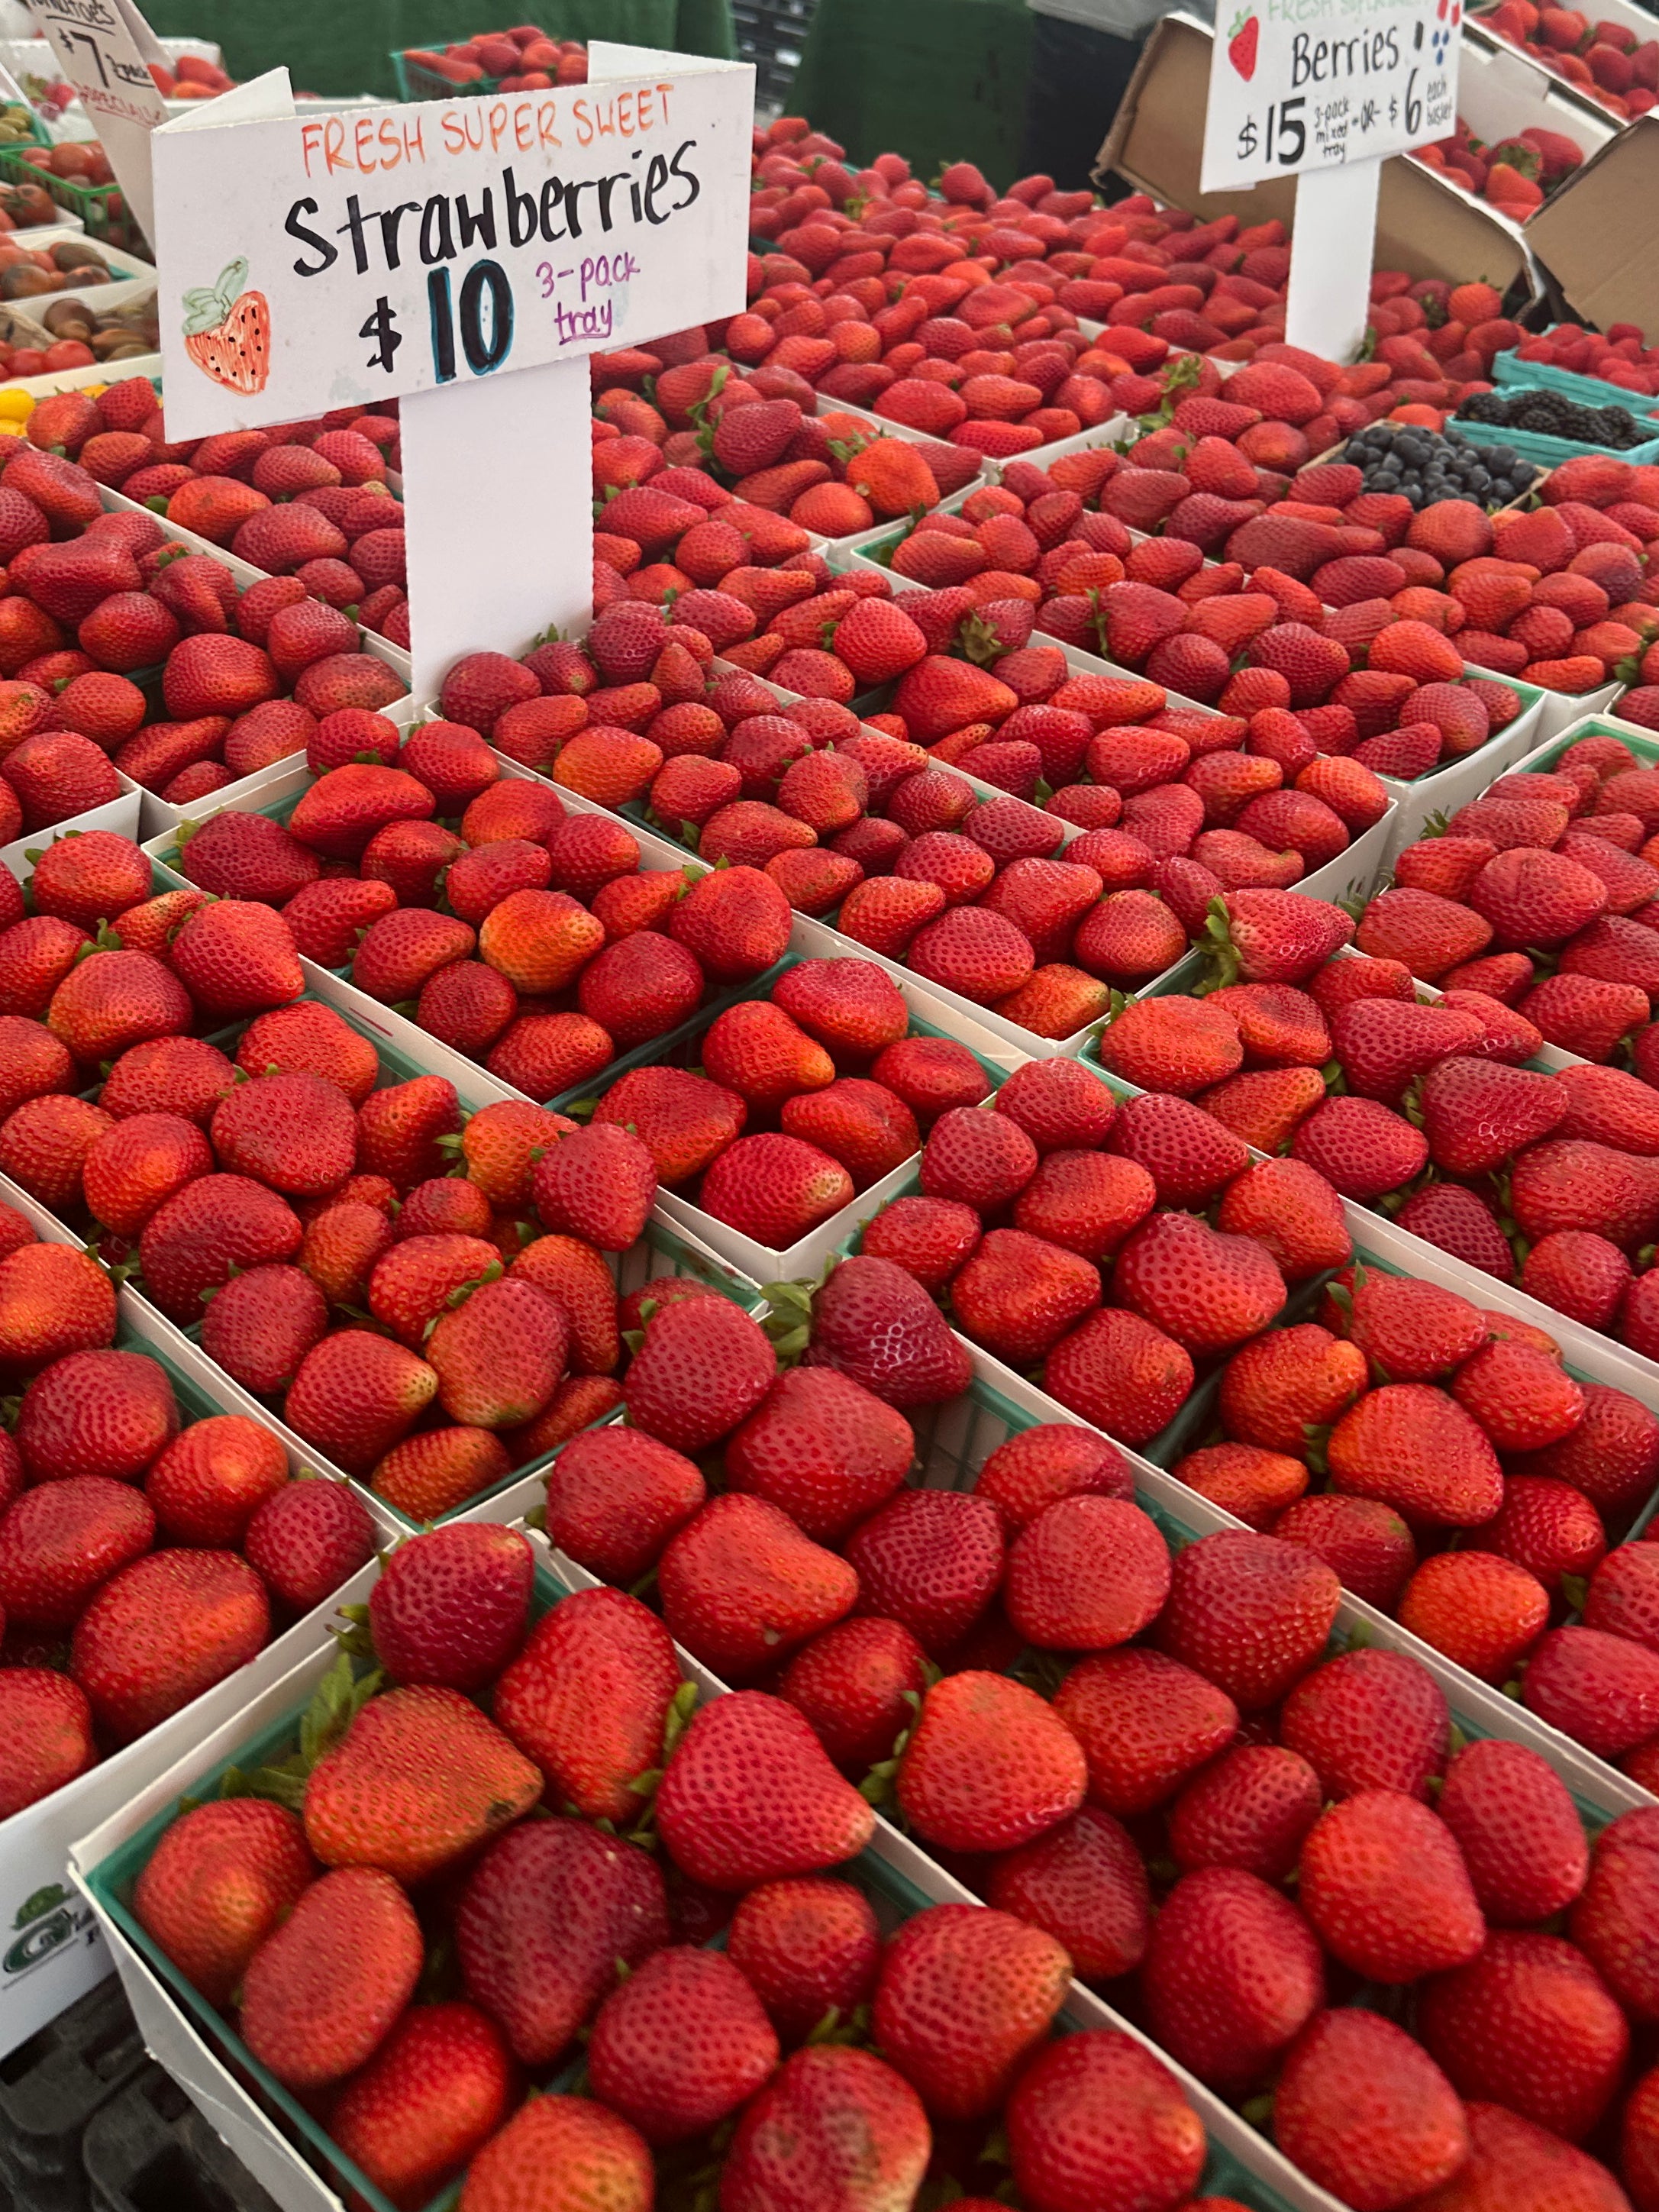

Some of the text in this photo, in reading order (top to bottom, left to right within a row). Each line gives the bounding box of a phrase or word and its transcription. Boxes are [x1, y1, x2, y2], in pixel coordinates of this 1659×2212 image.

[1292, 26, 1399, 89] Berries
[301, 84, 675, 179] FRESH SUPER SWEET
[1237, 96, 1306, 166] $15
[284, 140, 702, 277] Strawberries
[535, 250, 641, 302] 3-pack
[554, 299, 614, 345] tray
